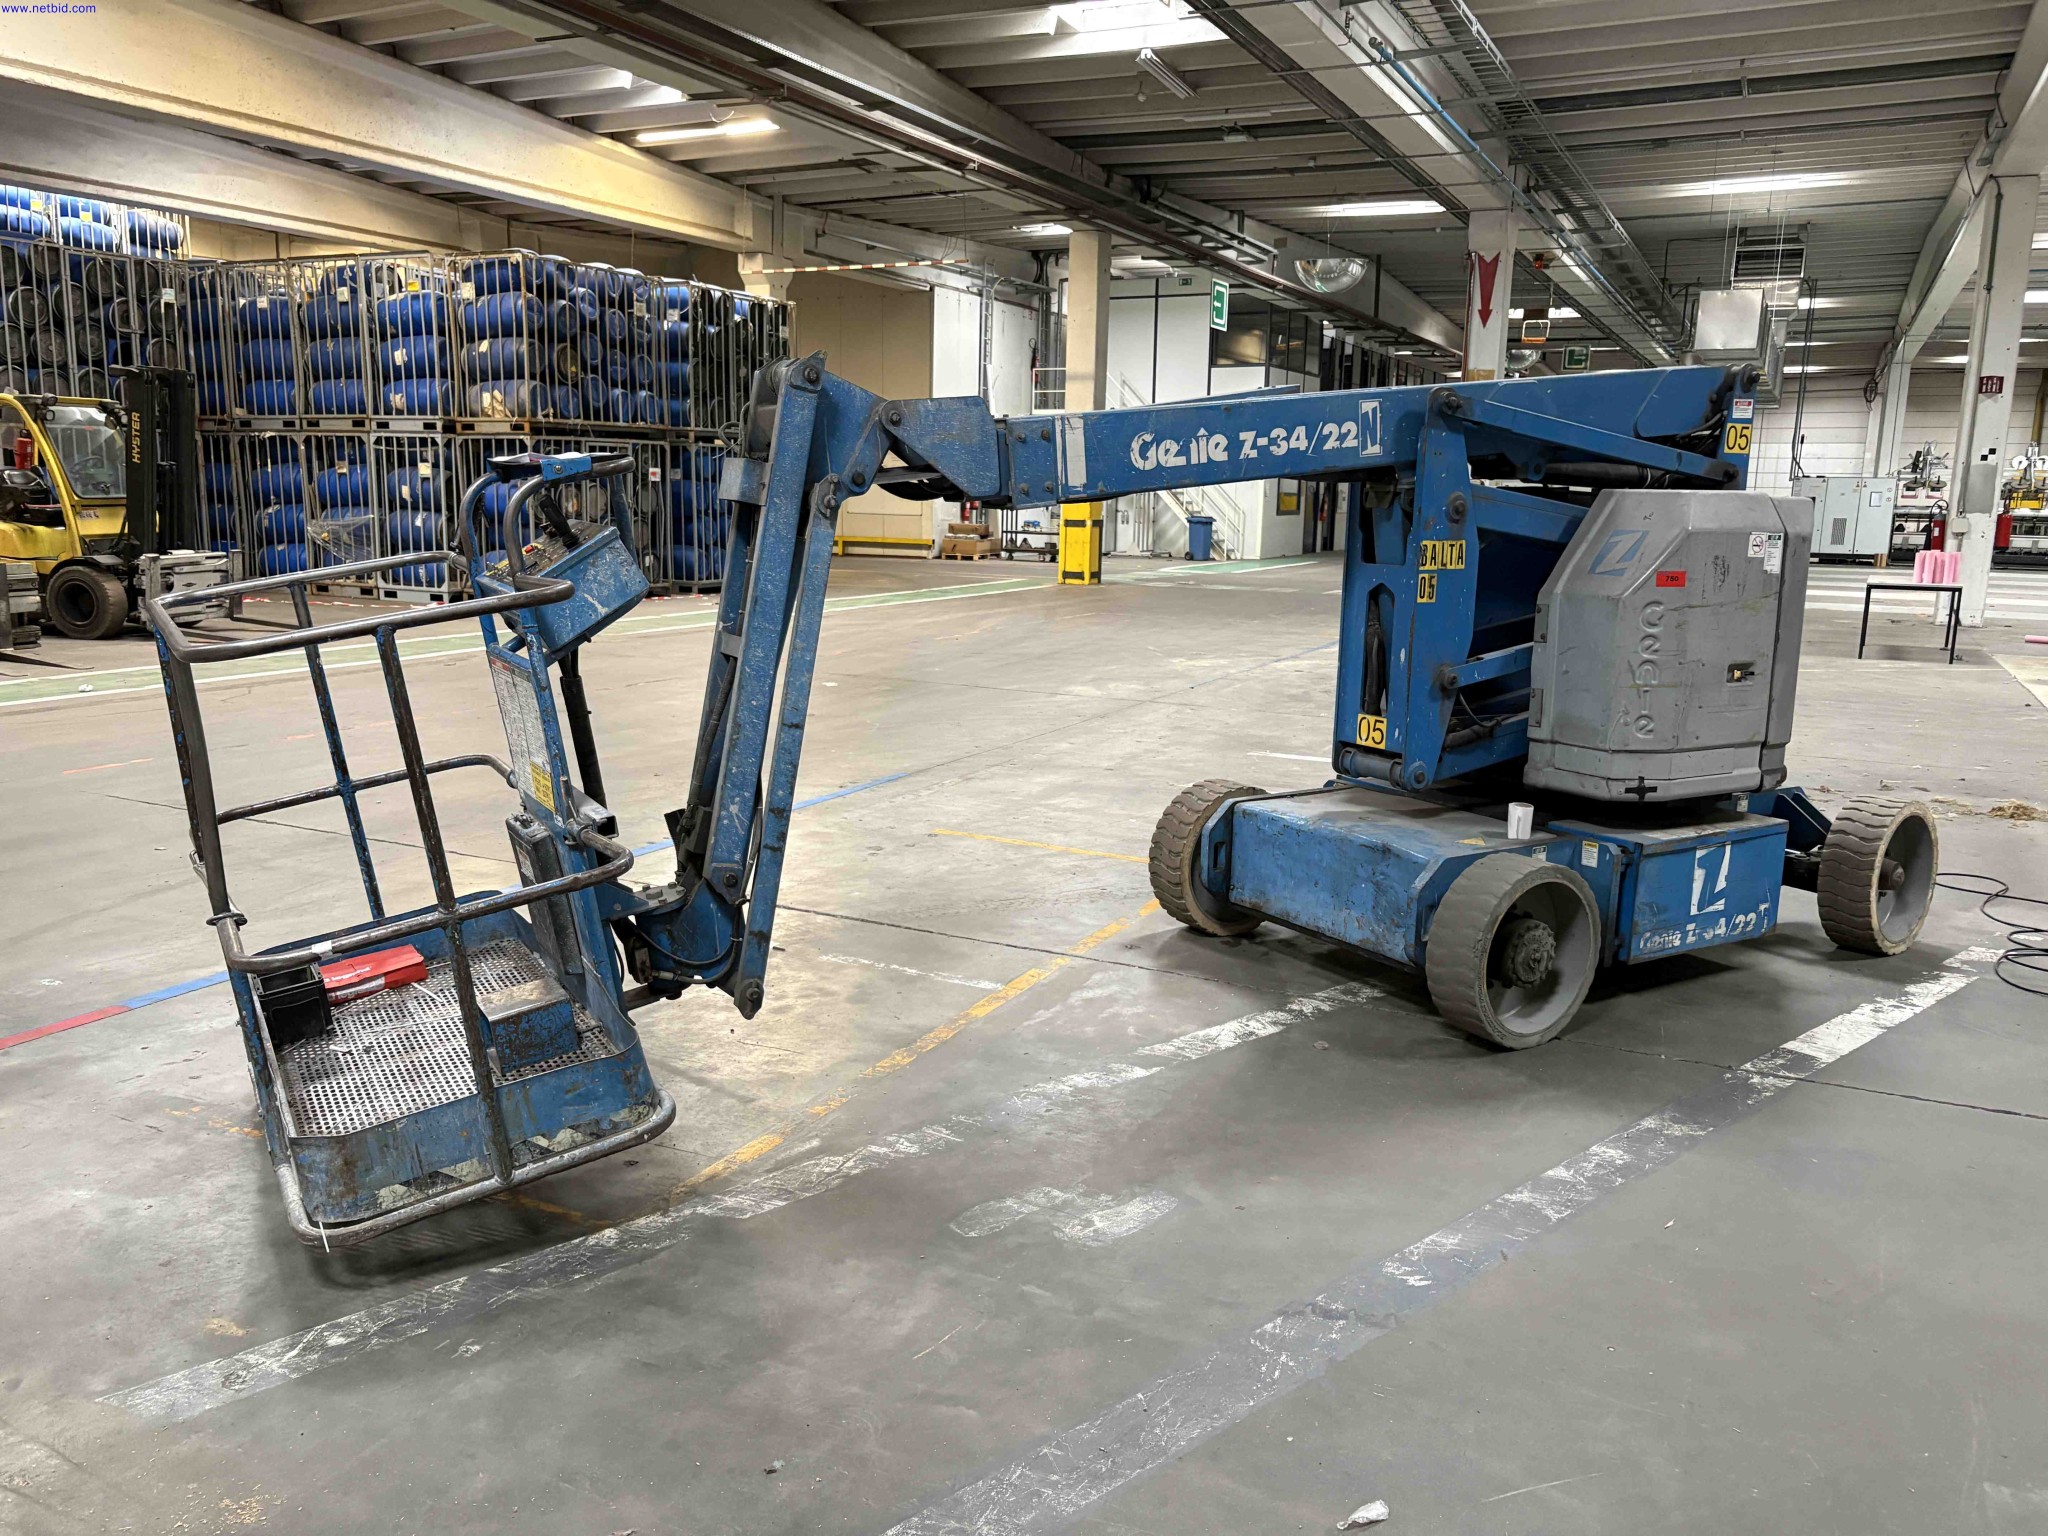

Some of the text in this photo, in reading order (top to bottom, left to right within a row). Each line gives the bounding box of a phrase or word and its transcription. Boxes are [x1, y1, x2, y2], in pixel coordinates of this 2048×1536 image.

[131, 411, 142, 464] HYSTER
[1129, 426, 1229, 472] Genie
[1238, 421, 1359, 460] Z-34/22
[1726, 425, 1750, 451] 05
[1419, 541, 1465, 568] BALTA
[1418, 575, 1436, 600] 05
[1633, 600, 1666, 739] Genie
[1358, 716, 1385, 746] 05
